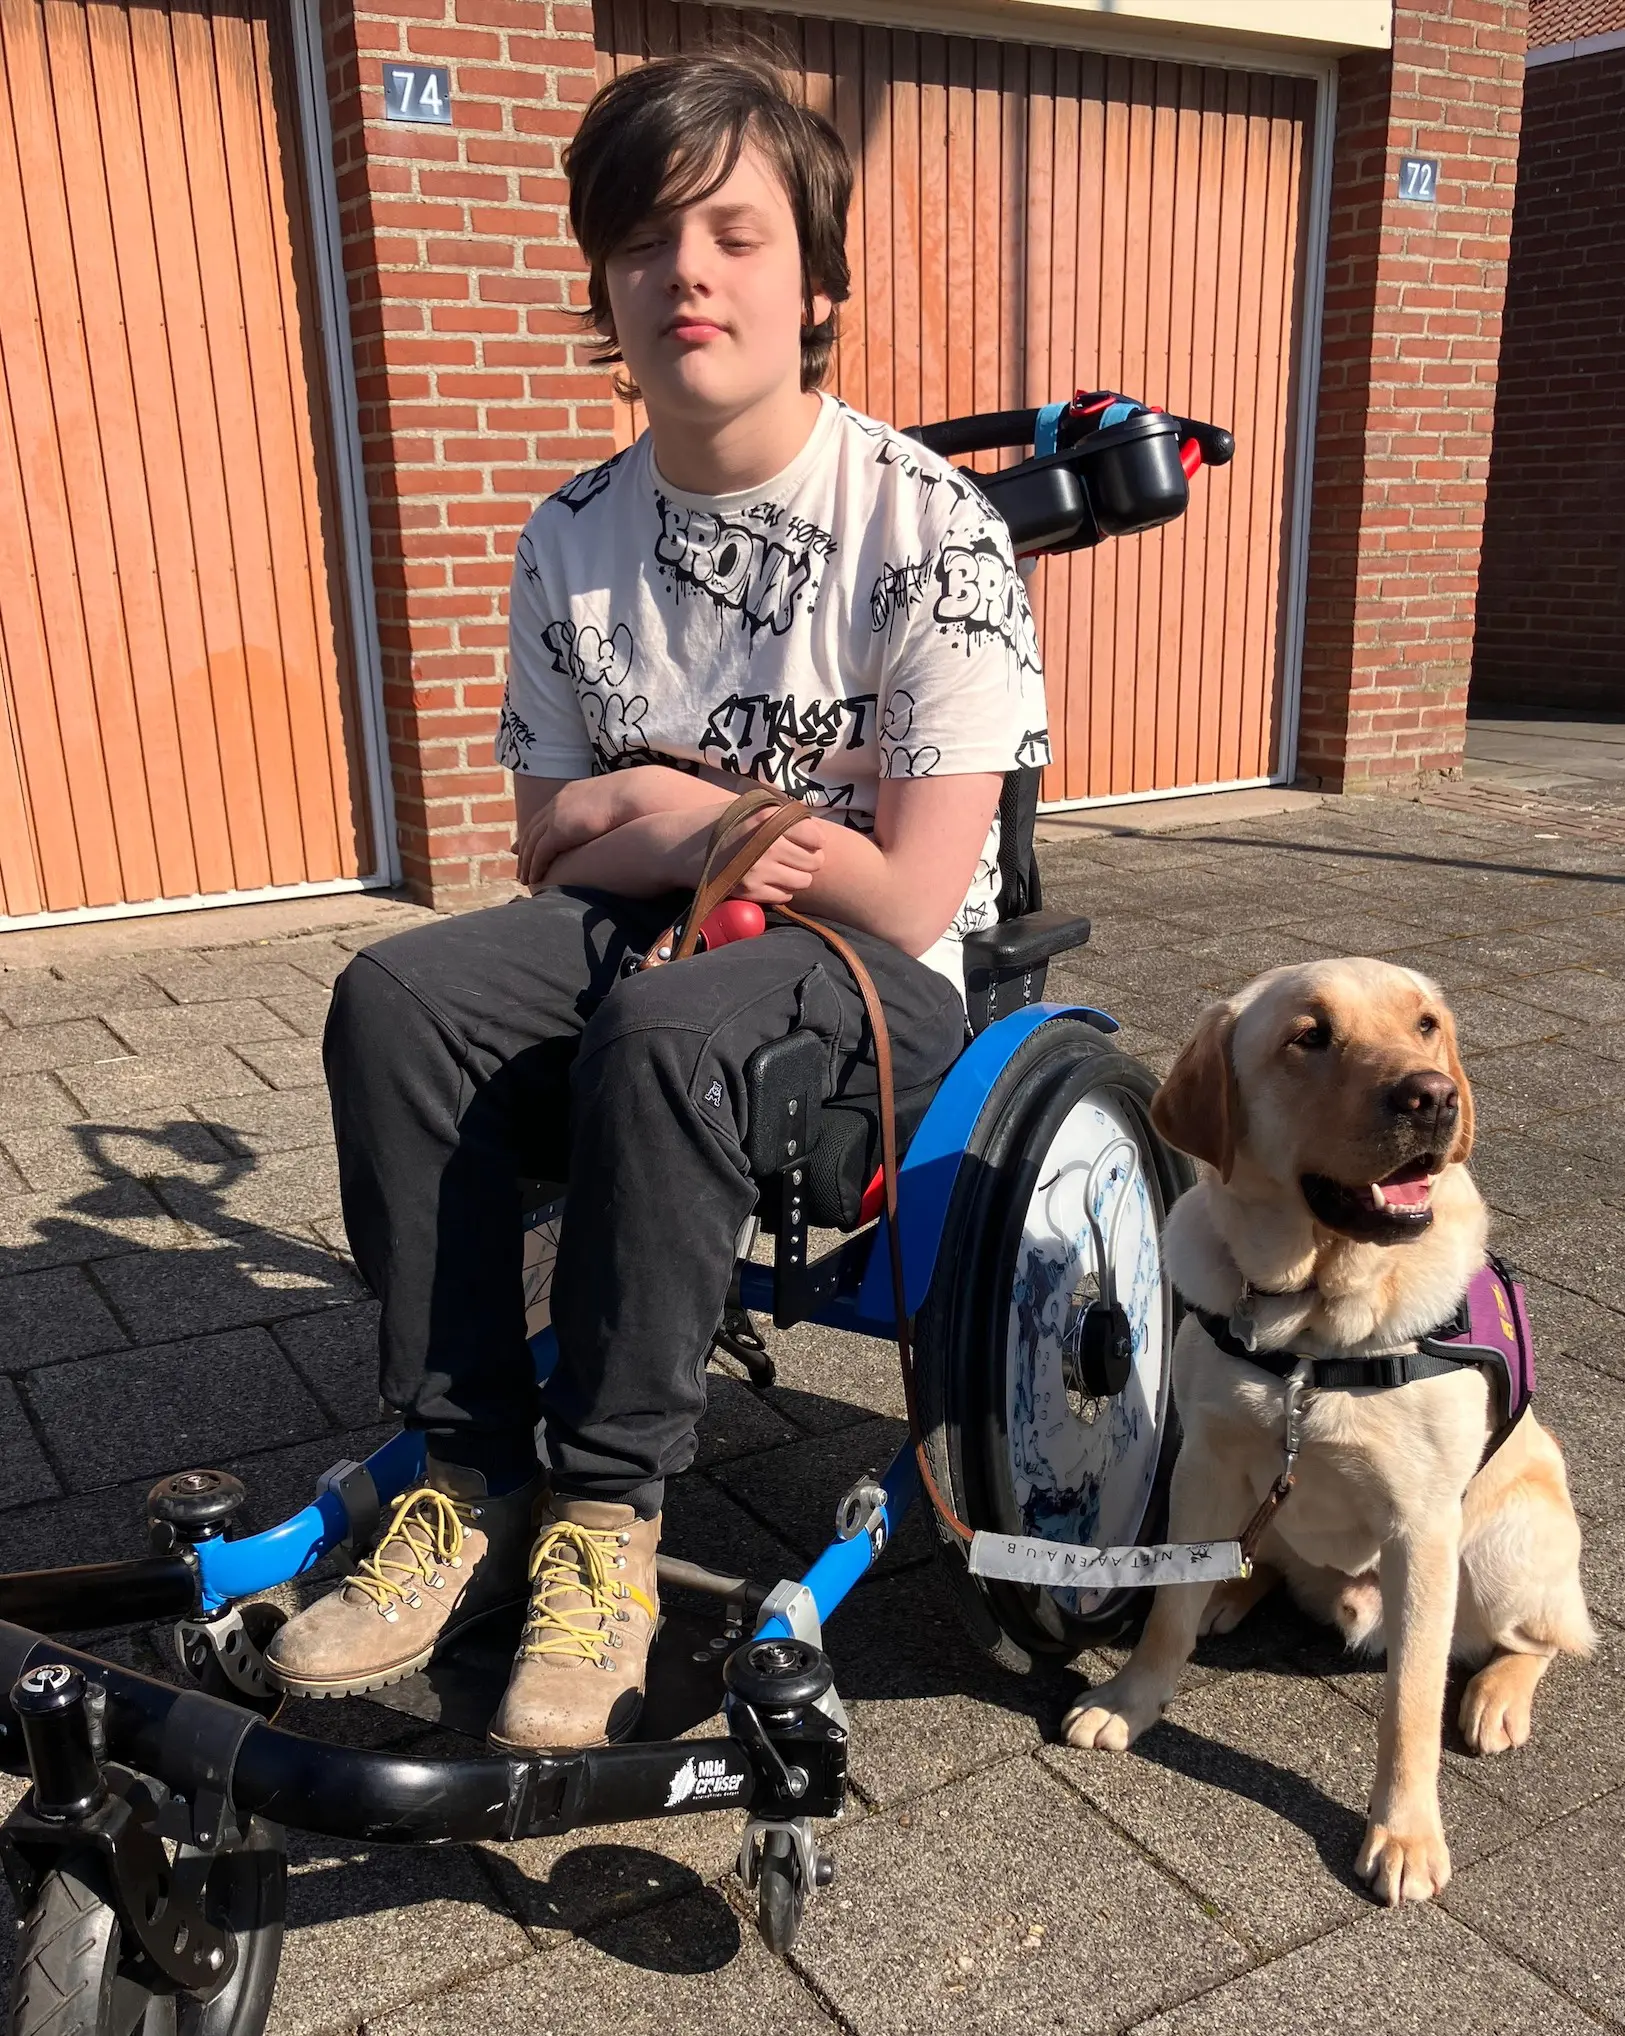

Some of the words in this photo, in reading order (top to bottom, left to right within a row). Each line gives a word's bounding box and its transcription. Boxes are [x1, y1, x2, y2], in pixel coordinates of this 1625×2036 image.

[392, 71, 443, 115] 74
[1407, 162, 1431, 195] 72
[1131, 1551, 1173, 1568] NIET
